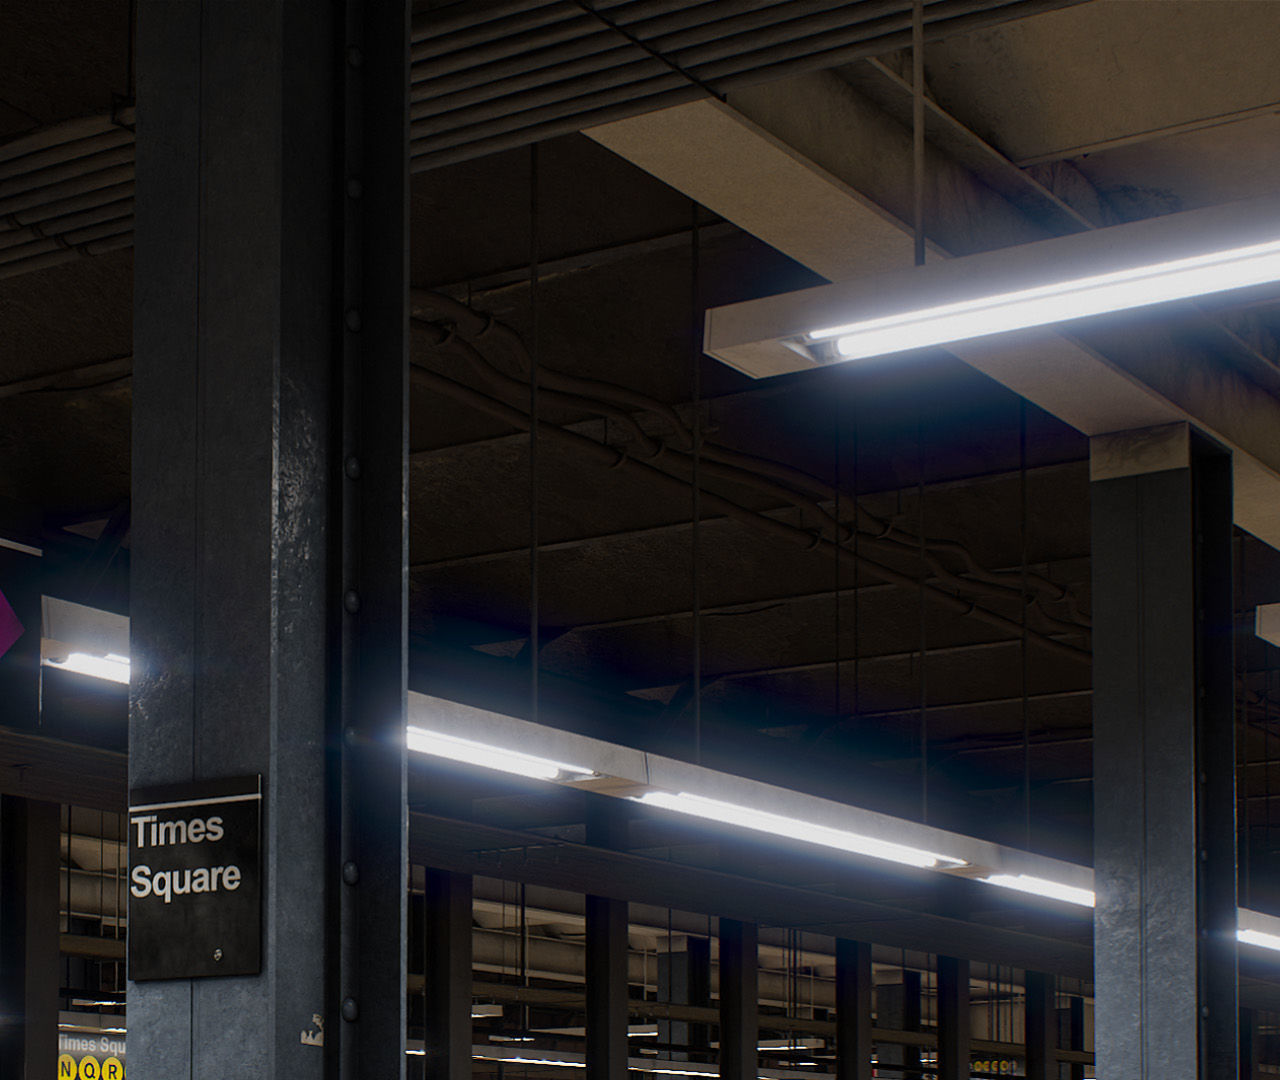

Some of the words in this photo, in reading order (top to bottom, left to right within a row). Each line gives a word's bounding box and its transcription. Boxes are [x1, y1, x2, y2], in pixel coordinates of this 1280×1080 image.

[130, 815, 225, 849] Times
[130, 863, 242, 904] Square
[100, 1036, 126, 1056] Squ
[61, 1061, 71, 1077] N
[84, 1062, 96, 1079] Q
[108, 1064, 117, 1080] R
